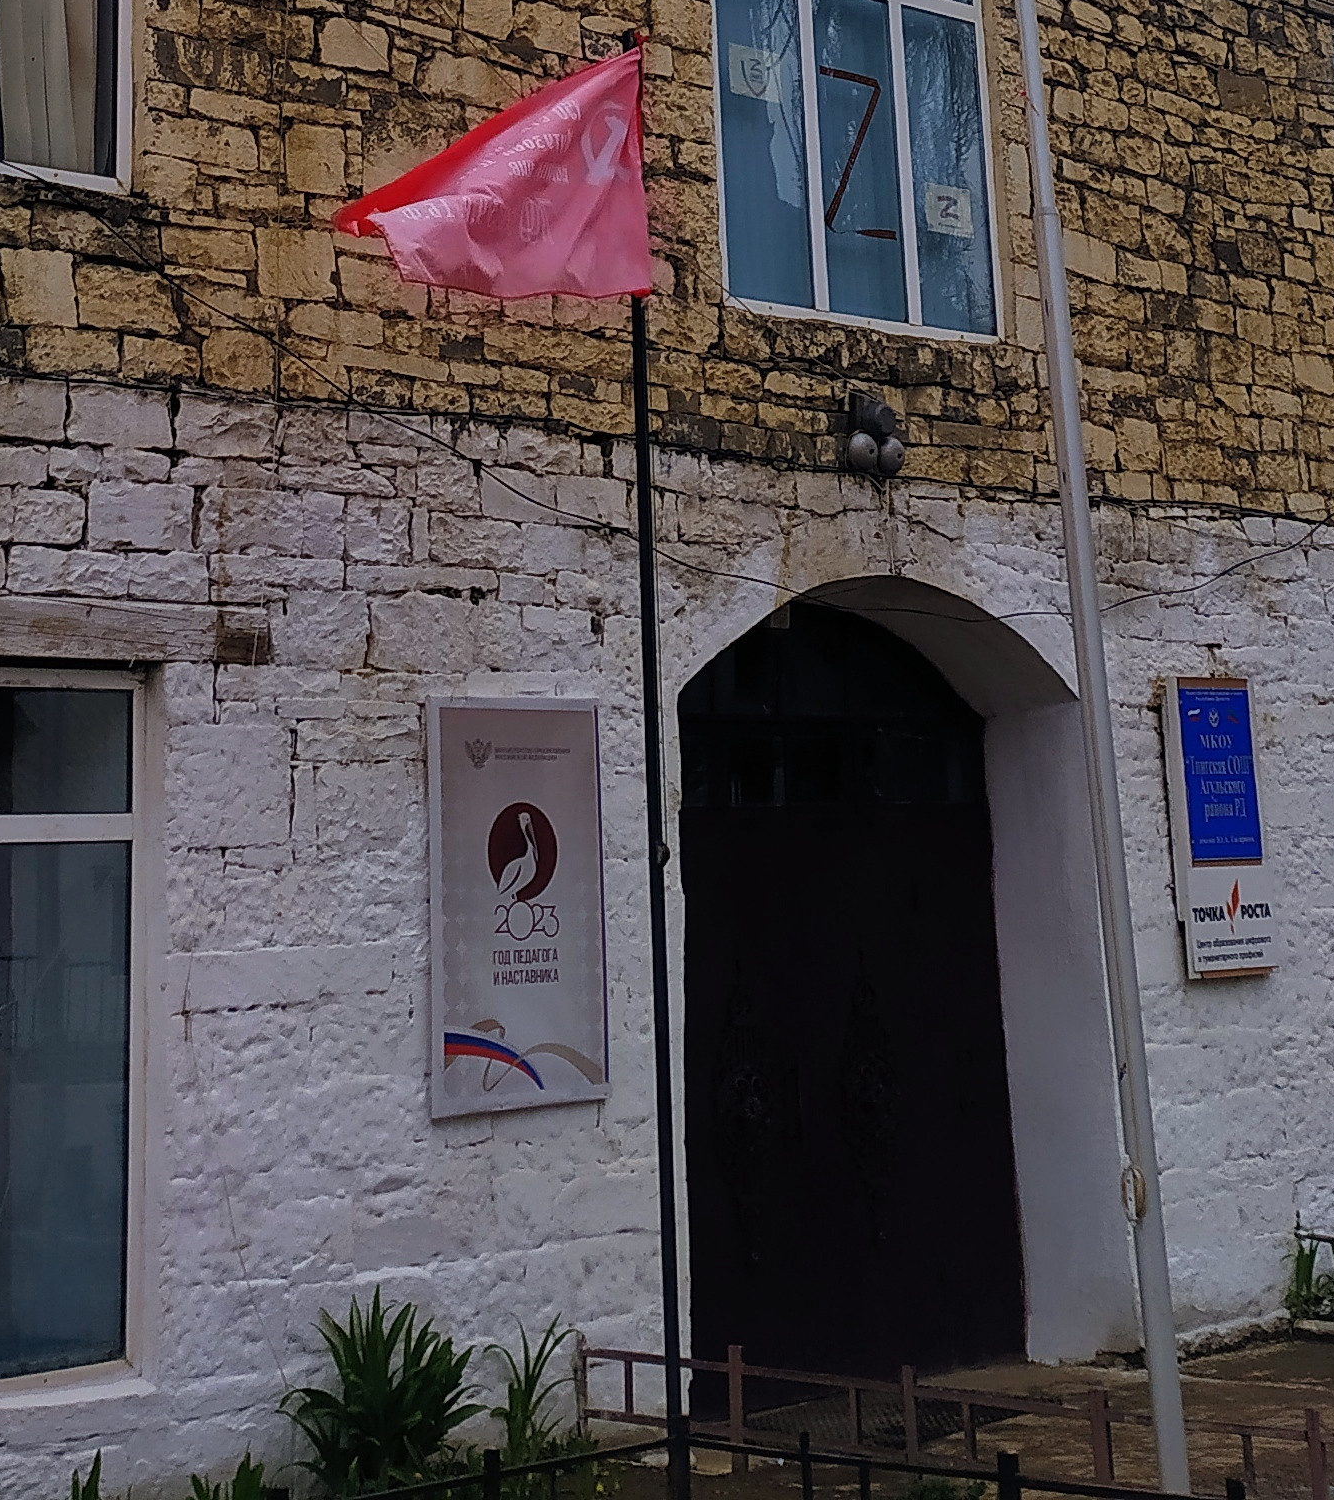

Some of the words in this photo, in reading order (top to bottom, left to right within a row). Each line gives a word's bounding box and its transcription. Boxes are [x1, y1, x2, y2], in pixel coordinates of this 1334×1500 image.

[819, 64, 898, 241] Z
[1199, 734, 1234, 749] МКОУ
[494, 900, 560, 941] 2023
[1192, 905, 1226, 923] ТОЧКА
[1240, 902, 1272, 919] РОСТА
[493, 949, 511, 966] ГОД
[514, 948, 559, 964] ПЕДАГОГА
[493, 971, 500, 986] И
[501, 969, 559, 986] НАСТАВНИКА
